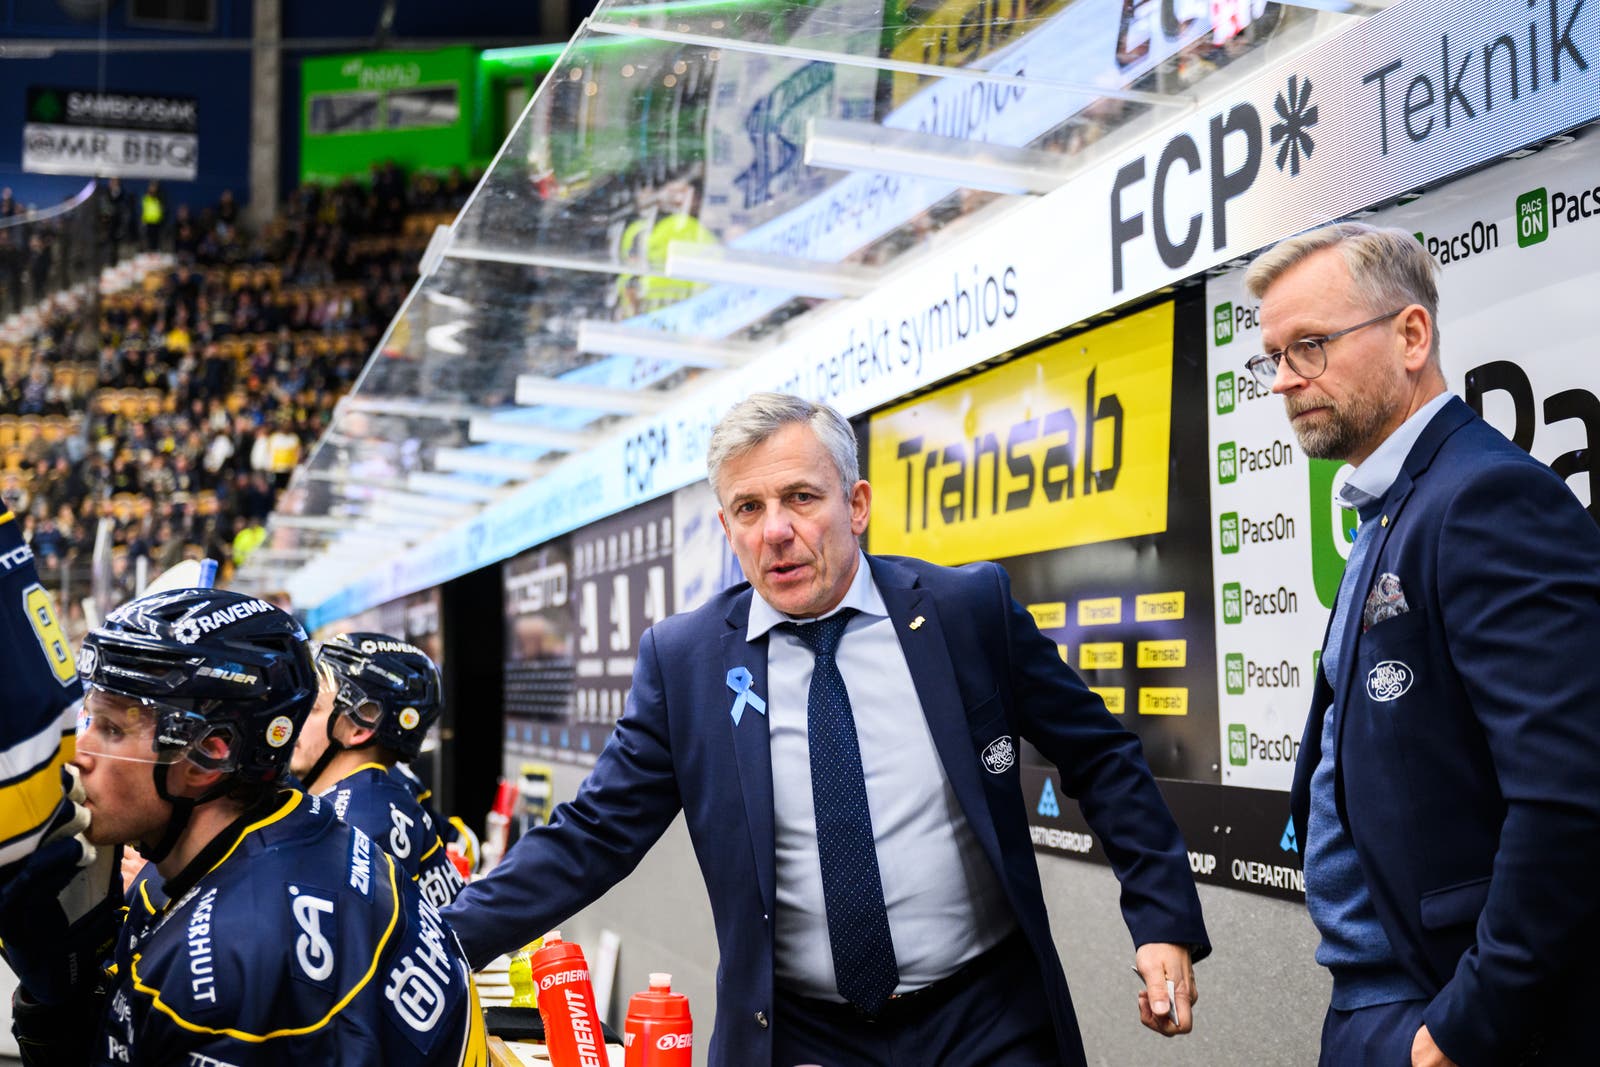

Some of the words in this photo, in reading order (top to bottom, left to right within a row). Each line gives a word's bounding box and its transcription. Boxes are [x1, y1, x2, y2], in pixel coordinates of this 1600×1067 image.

[1362, 0, 1589, 156] Teknik
[1520, 198, 1543, 215] PACS
[1521, 211, 1544, 237] ON
[1428, 220, 1499, 266] PacsOn
[815, 318, 893, 404] perfekt
[898, 263, 1020, 377] symbios
[896, 364, 1125, 534] Transab
[1239, 439, 1293, 474] PacsOn
[1241, 512, 1296, 545] PacsOn
[197, 599, 276, 634] RAVEMA
[1141, 600, 1179, 615] Transab
[1244, 586, 1298, 616] PacsOn
[22, 582, 79, 688] 8
[1143, 646, 1180, 662] Transab
[195, 666, 258, 686] BAUER
[1246, 659, 1300, 689] PacsOn
[1145, 694, 1183, 709] Transab
[564, 988, 601, 1067] ENERVIT
